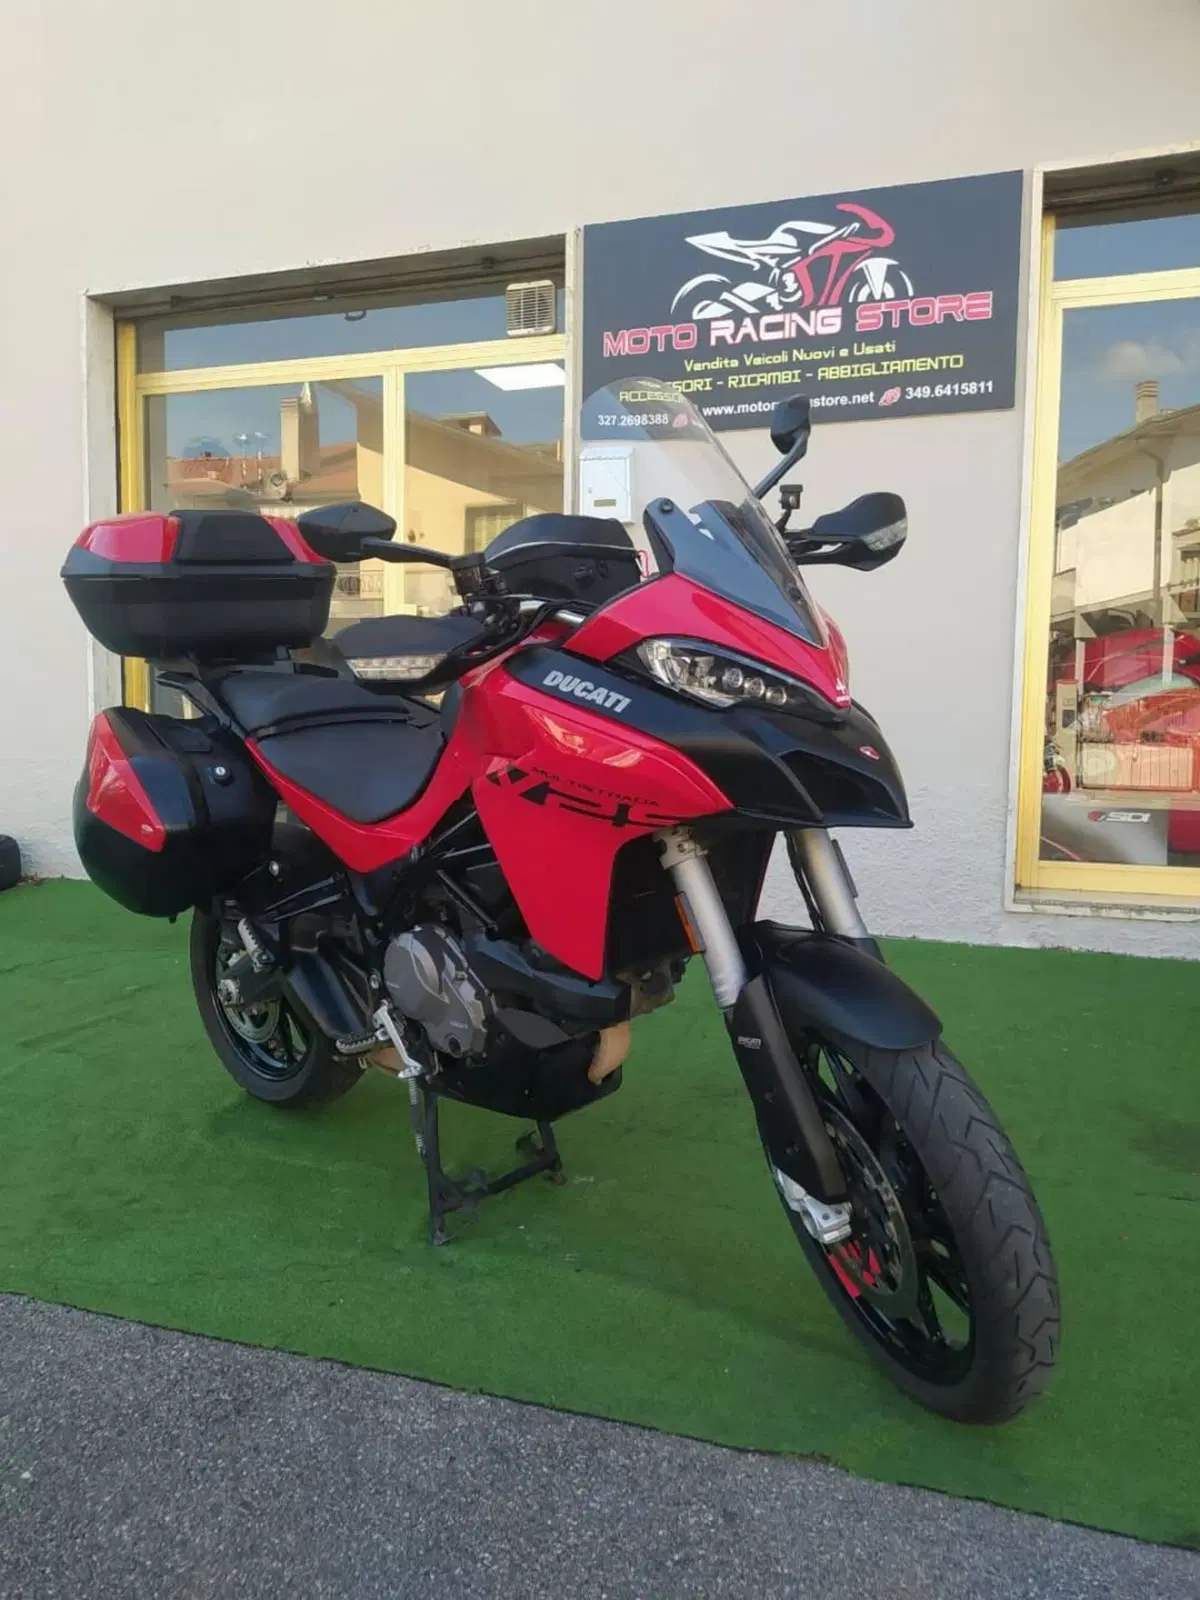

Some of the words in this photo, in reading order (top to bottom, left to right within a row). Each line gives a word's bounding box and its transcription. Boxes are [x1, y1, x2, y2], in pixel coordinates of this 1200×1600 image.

[603, 323, 698, 357] MOTO
[710, 307, 843, 346] RACING
[856, 291, 994, 332] STORE
[684, 359, 739, 373] Vendita
[743, 352, 789, 366] Veicoli
[792, 346, 836, 362] Nuovi
[839, 349, 849, 358] e
[853, 339, 897, 356] Usati
[728, 369, 801, 389] RICAMBI
[817, 354, 965, 381] ABBIGLIAMENTO
[702, 391, 876, 417] www.motorstore.net
[905, 380, 994, 400] 349.6415811
[542, 670, 632, 713] DUCATI
